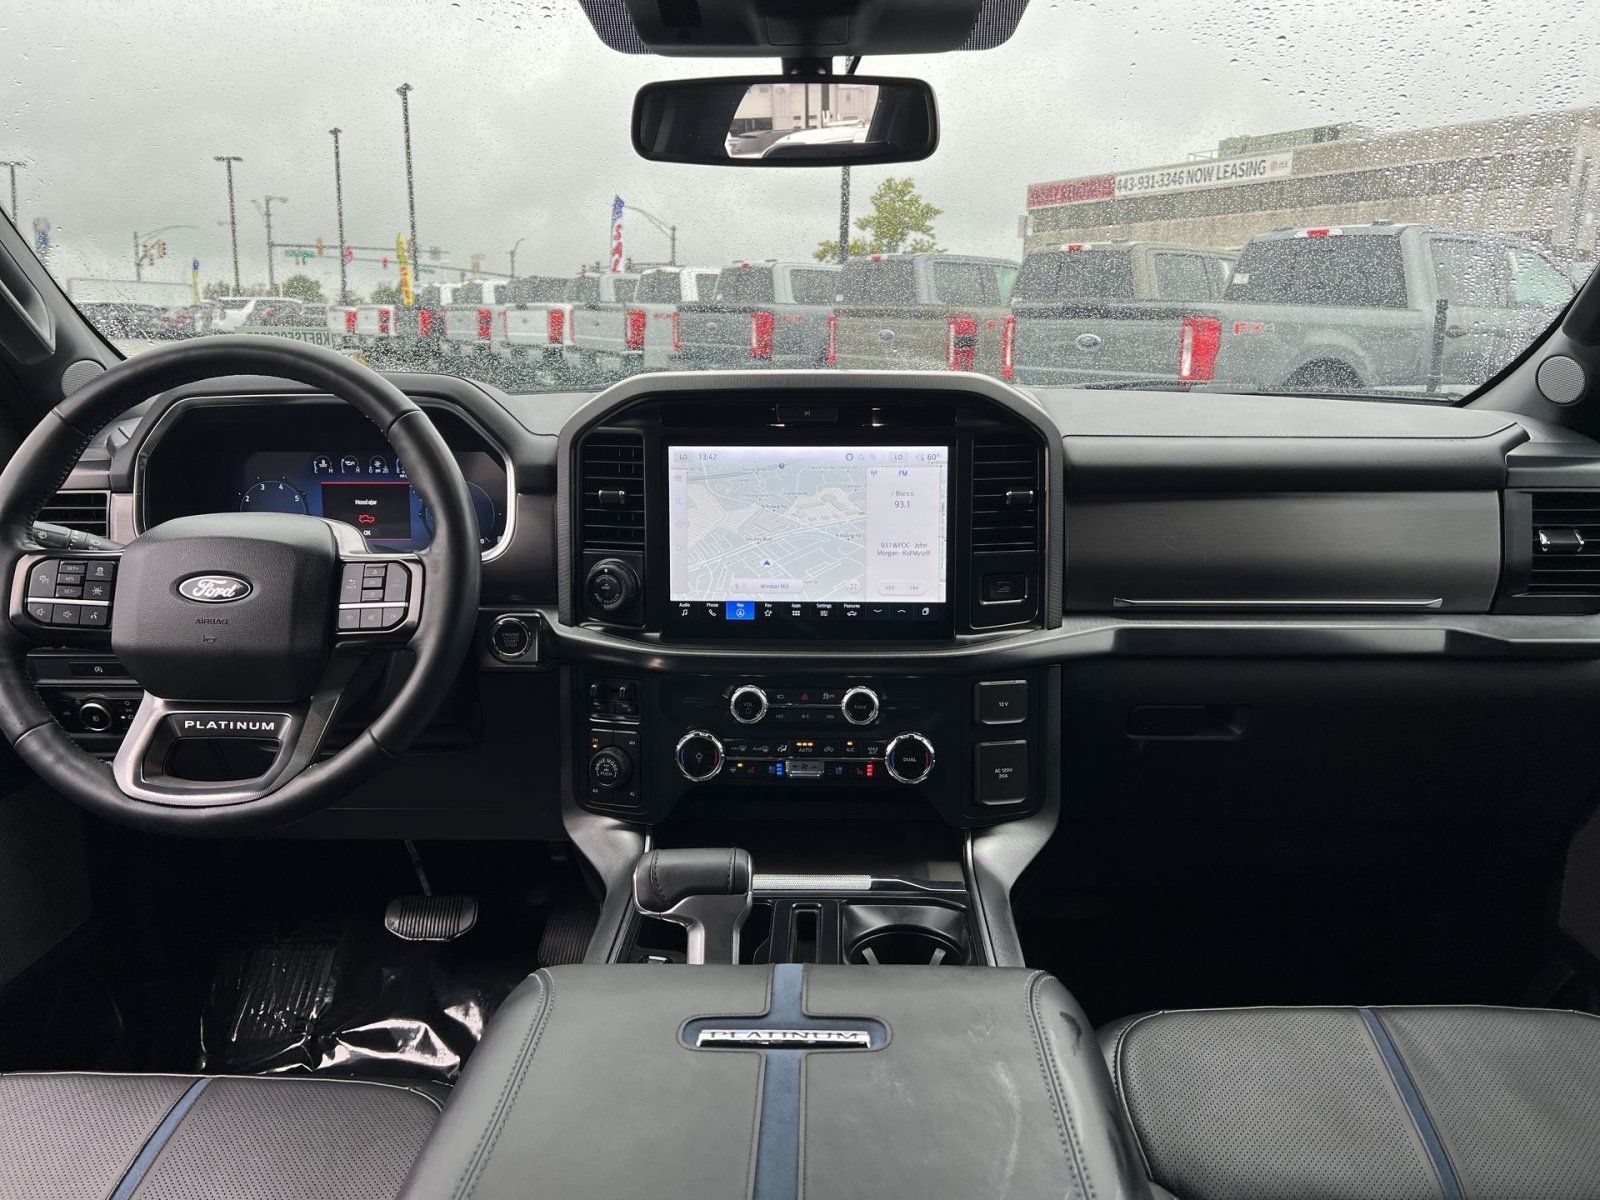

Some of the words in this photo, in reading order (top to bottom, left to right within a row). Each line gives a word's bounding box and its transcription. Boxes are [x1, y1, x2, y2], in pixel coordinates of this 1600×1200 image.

[1116, 175, 1184, 193] 443-931-3346
[1186, 169, 1215, 186] NOW
[1216, 159, 1267, 181] LEASING
[699, 453, 718, 461] 13:42
[894, 453, 904, 461] LO
[294, 494, 300, 502] 5
[894, 500, 910, 509] 93.1
[190, 578, 244, 598] Ford
[816, 602, 833, 610] Settings
[194, 618, 229, 626] AIRBAG
[184, 719, 276, 731] PLATINUM
[711, 1031, 858, 1040] PLATINUM
